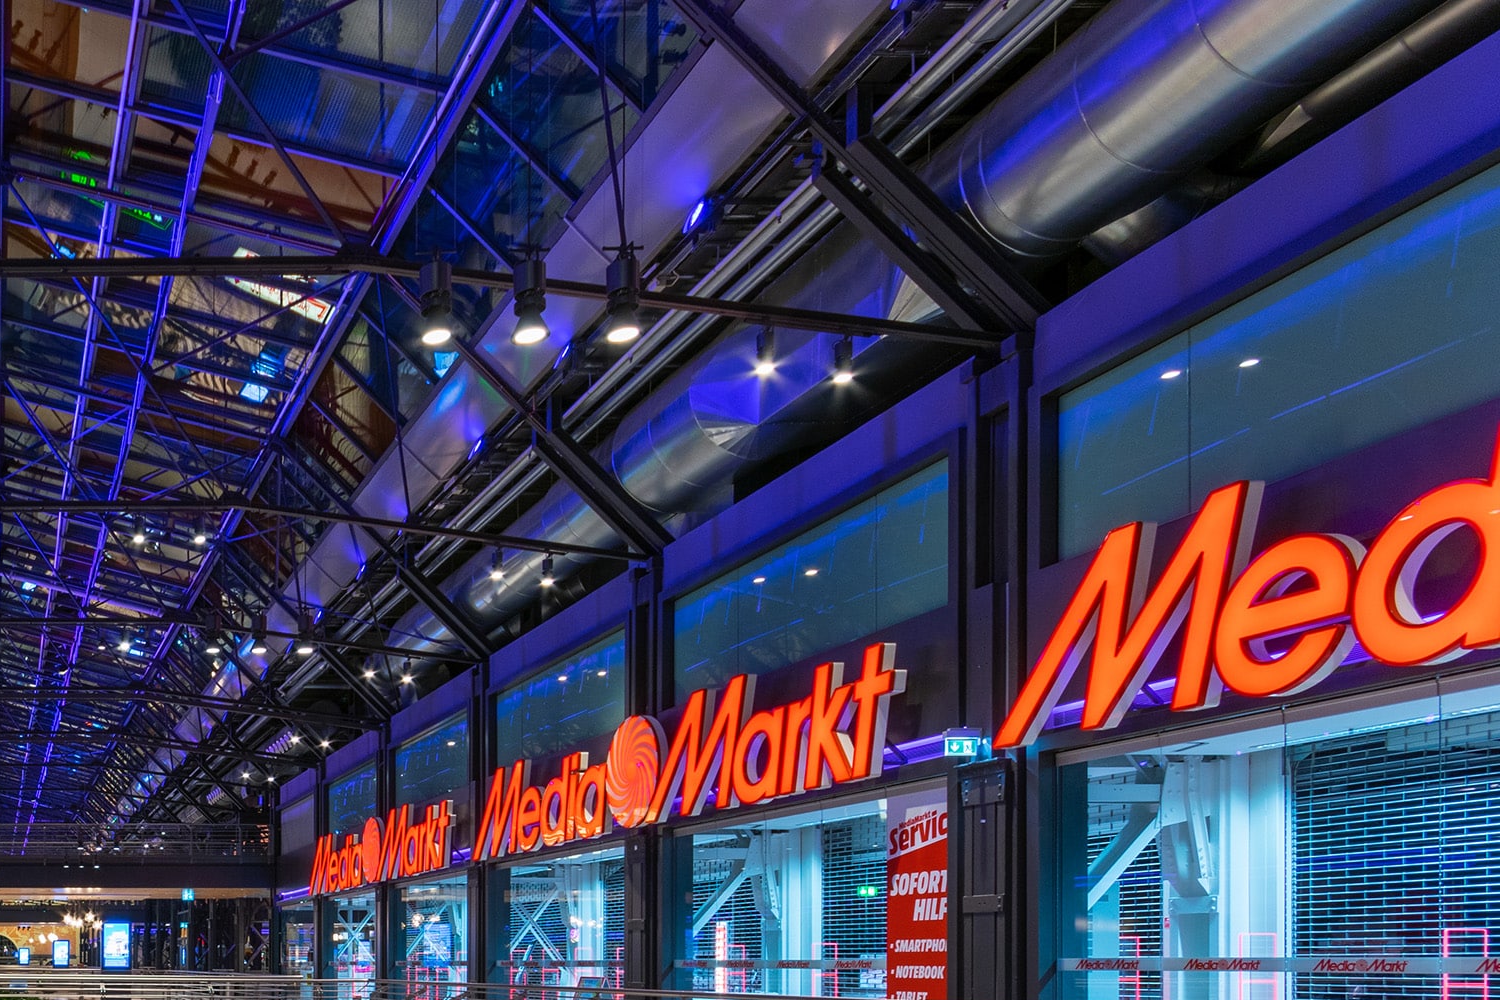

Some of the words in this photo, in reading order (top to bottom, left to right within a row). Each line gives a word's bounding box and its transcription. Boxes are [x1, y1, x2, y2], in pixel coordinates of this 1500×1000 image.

[472, 752, 615, 862] Media
[643, 642, 902, 824] Markt
[308, 833, 364, 897] Media
[375, 799, 452, 882] Markt
[894, 938, 948, 953] SMARTPHO
[1075, 959, 1105, 970] Media
[1111, 959, 1140, 970] Markt
[1183, 958, 1219, 970] Media
[1227, 958, 1261, 970] Markt
[1313, 958, 1356, 972] Media
[1366, 958, 1409, 972] Markt
[894, 965, 945, 979] NOTEBOOK
